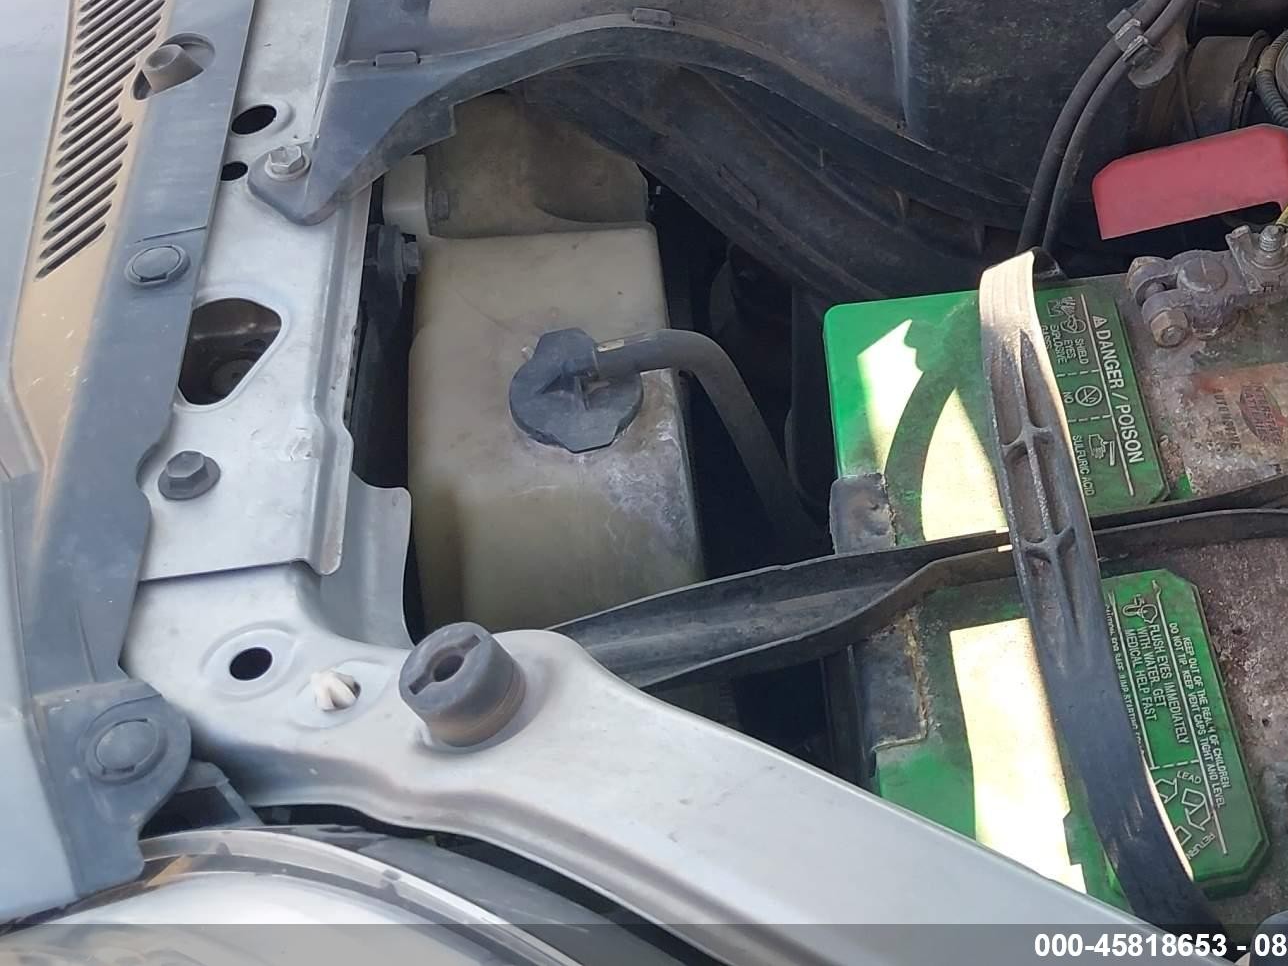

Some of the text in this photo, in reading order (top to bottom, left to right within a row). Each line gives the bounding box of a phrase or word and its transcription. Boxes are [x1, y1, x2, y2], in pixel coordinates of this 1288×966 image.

[1064, 339, 1077, 359] EYES
[1075, 338, 1089, 365] SHIELD
[1063, 391, 1074, 404] NO
[1096, 330, 1125, 389] DANGER
[1115, 404, 1145, 463] POISON
[1072, 434, 1095, 496] SULFURIC ACID
[1169, 622, 1179, 634] DO
[1172, 635, 1184, 652] NOT
[1183, 636, 1195, 657] KEEP
[1125, 628, 1157, 721] MEDICAL HELP FAST
[1137, 625, 1151, 650] WITH
[1152, 688, 1167, 707] GET
[1188, 657, 1200, 674] OUT
[1149, 624, 1190, 744] FLUSH EYES IMMEDIATELY
[1182, 670, 1194, 690] KEEP
[1193, 675, 1203, 688] OF
[1187, 692, 1201, 715] VENT
[1197, 688, 1208, 706] THE
[1194, 714, 1206, 736] CAPS
[1200, 737, 1213, 761] TIGHT
[1209, 734, 1219, 746] OF
[1177, 770, 1202, 784] LEAD
[1207, 764, 1218, 781] AND
[1212, 747, 1231, 789] CHILDREN
[1211, 783, 1225, 808] LEVEL
